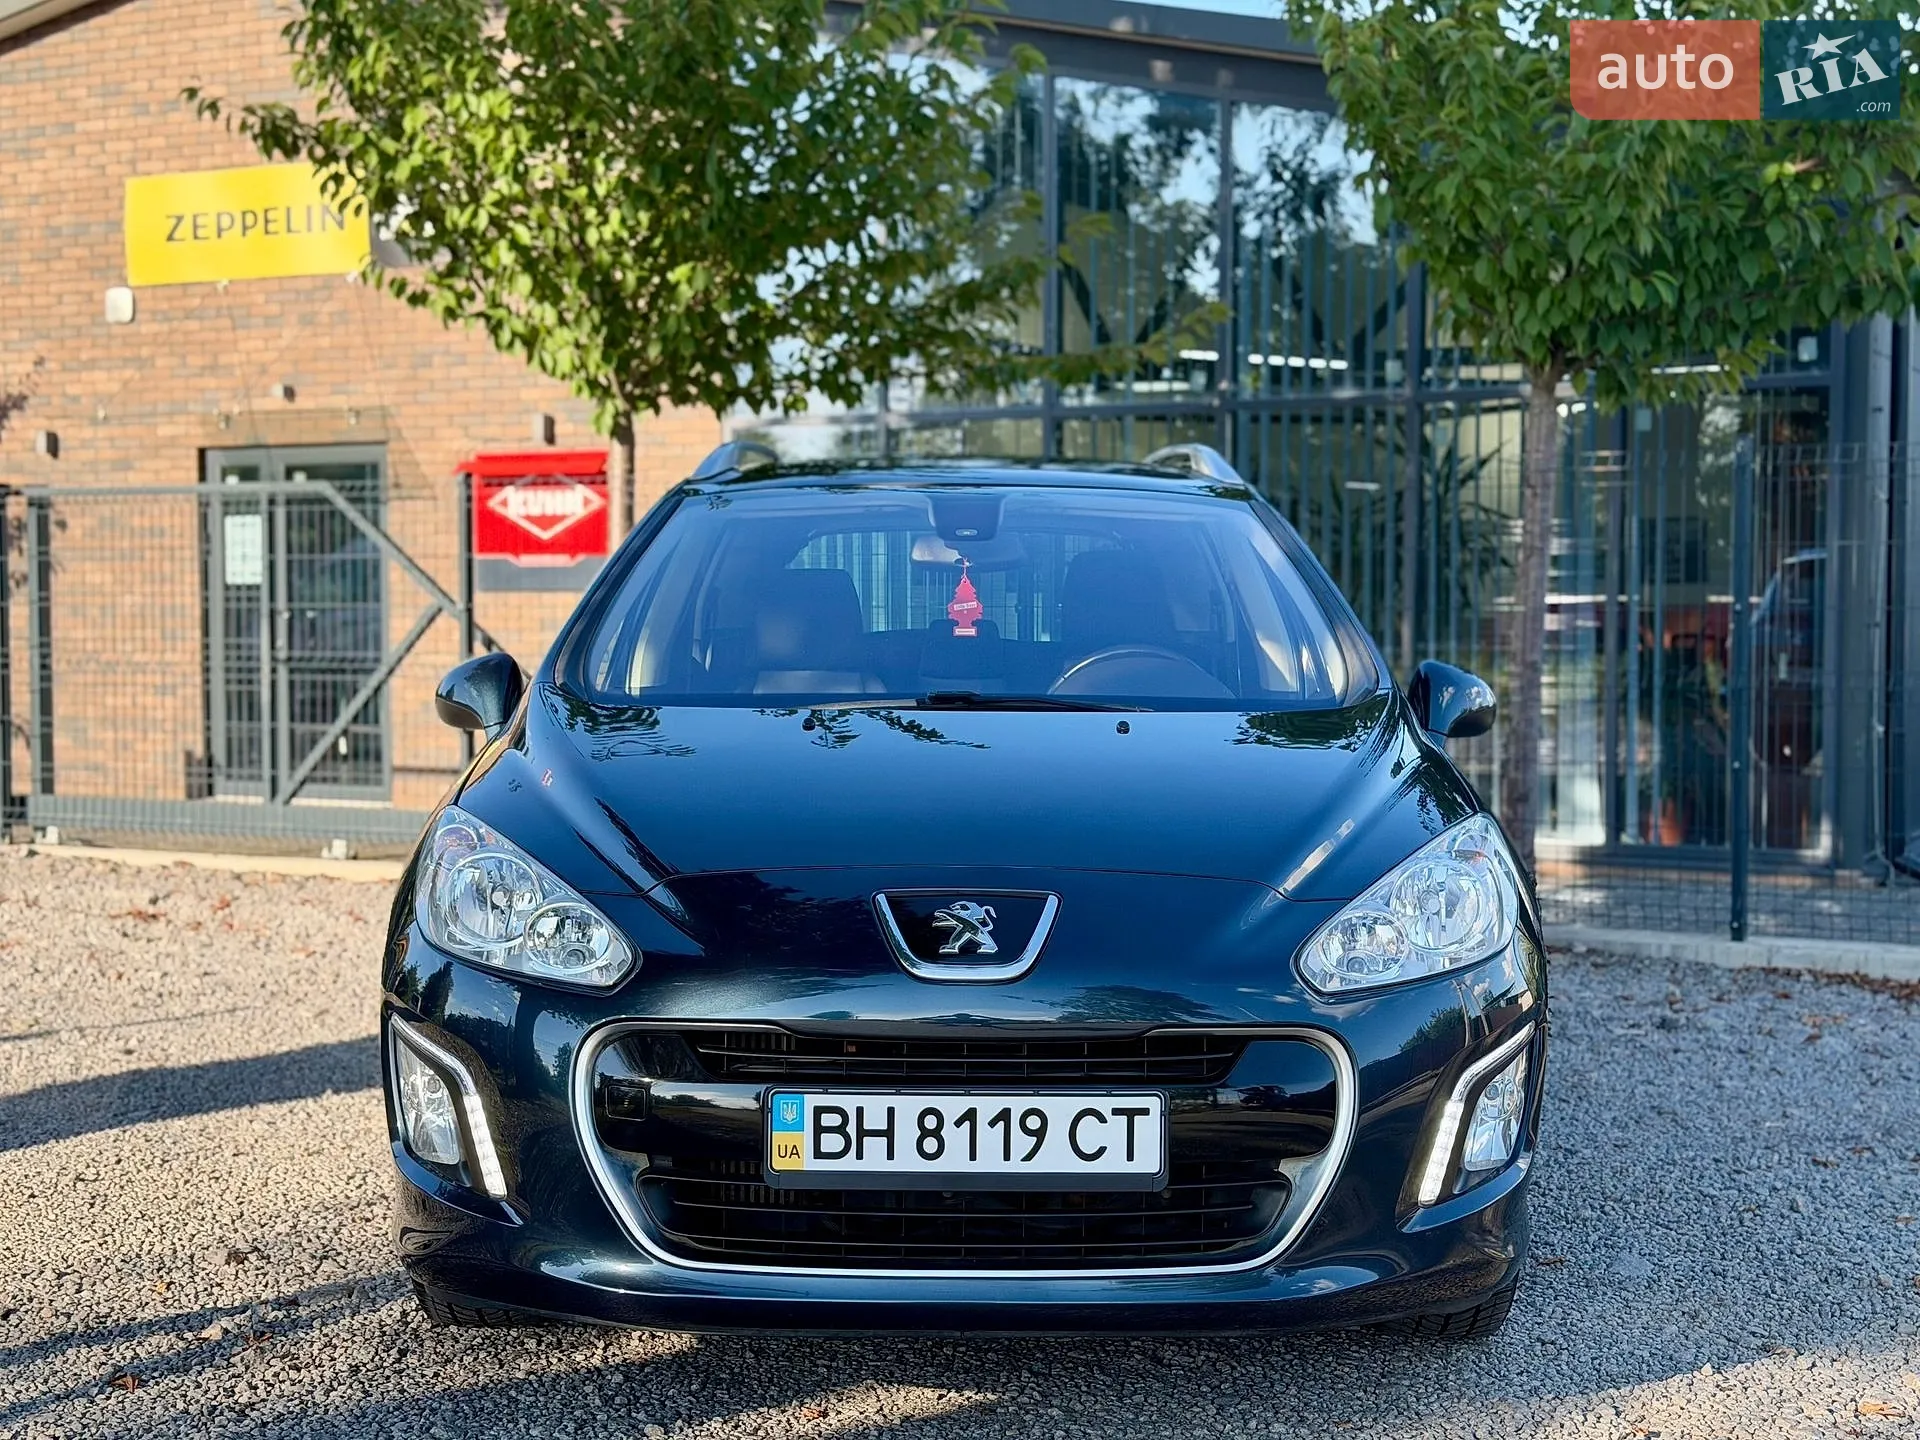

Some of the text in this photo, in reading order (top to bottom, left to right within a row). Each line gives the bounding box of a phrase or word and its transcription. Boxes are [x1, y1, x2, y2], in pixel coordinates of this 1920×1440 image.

[165, 204, 345, 243] ZEPPELIN
[777, 1145, 800, 1159] UA
[812, 1105, 1150, 1162] BH 8119 CT
